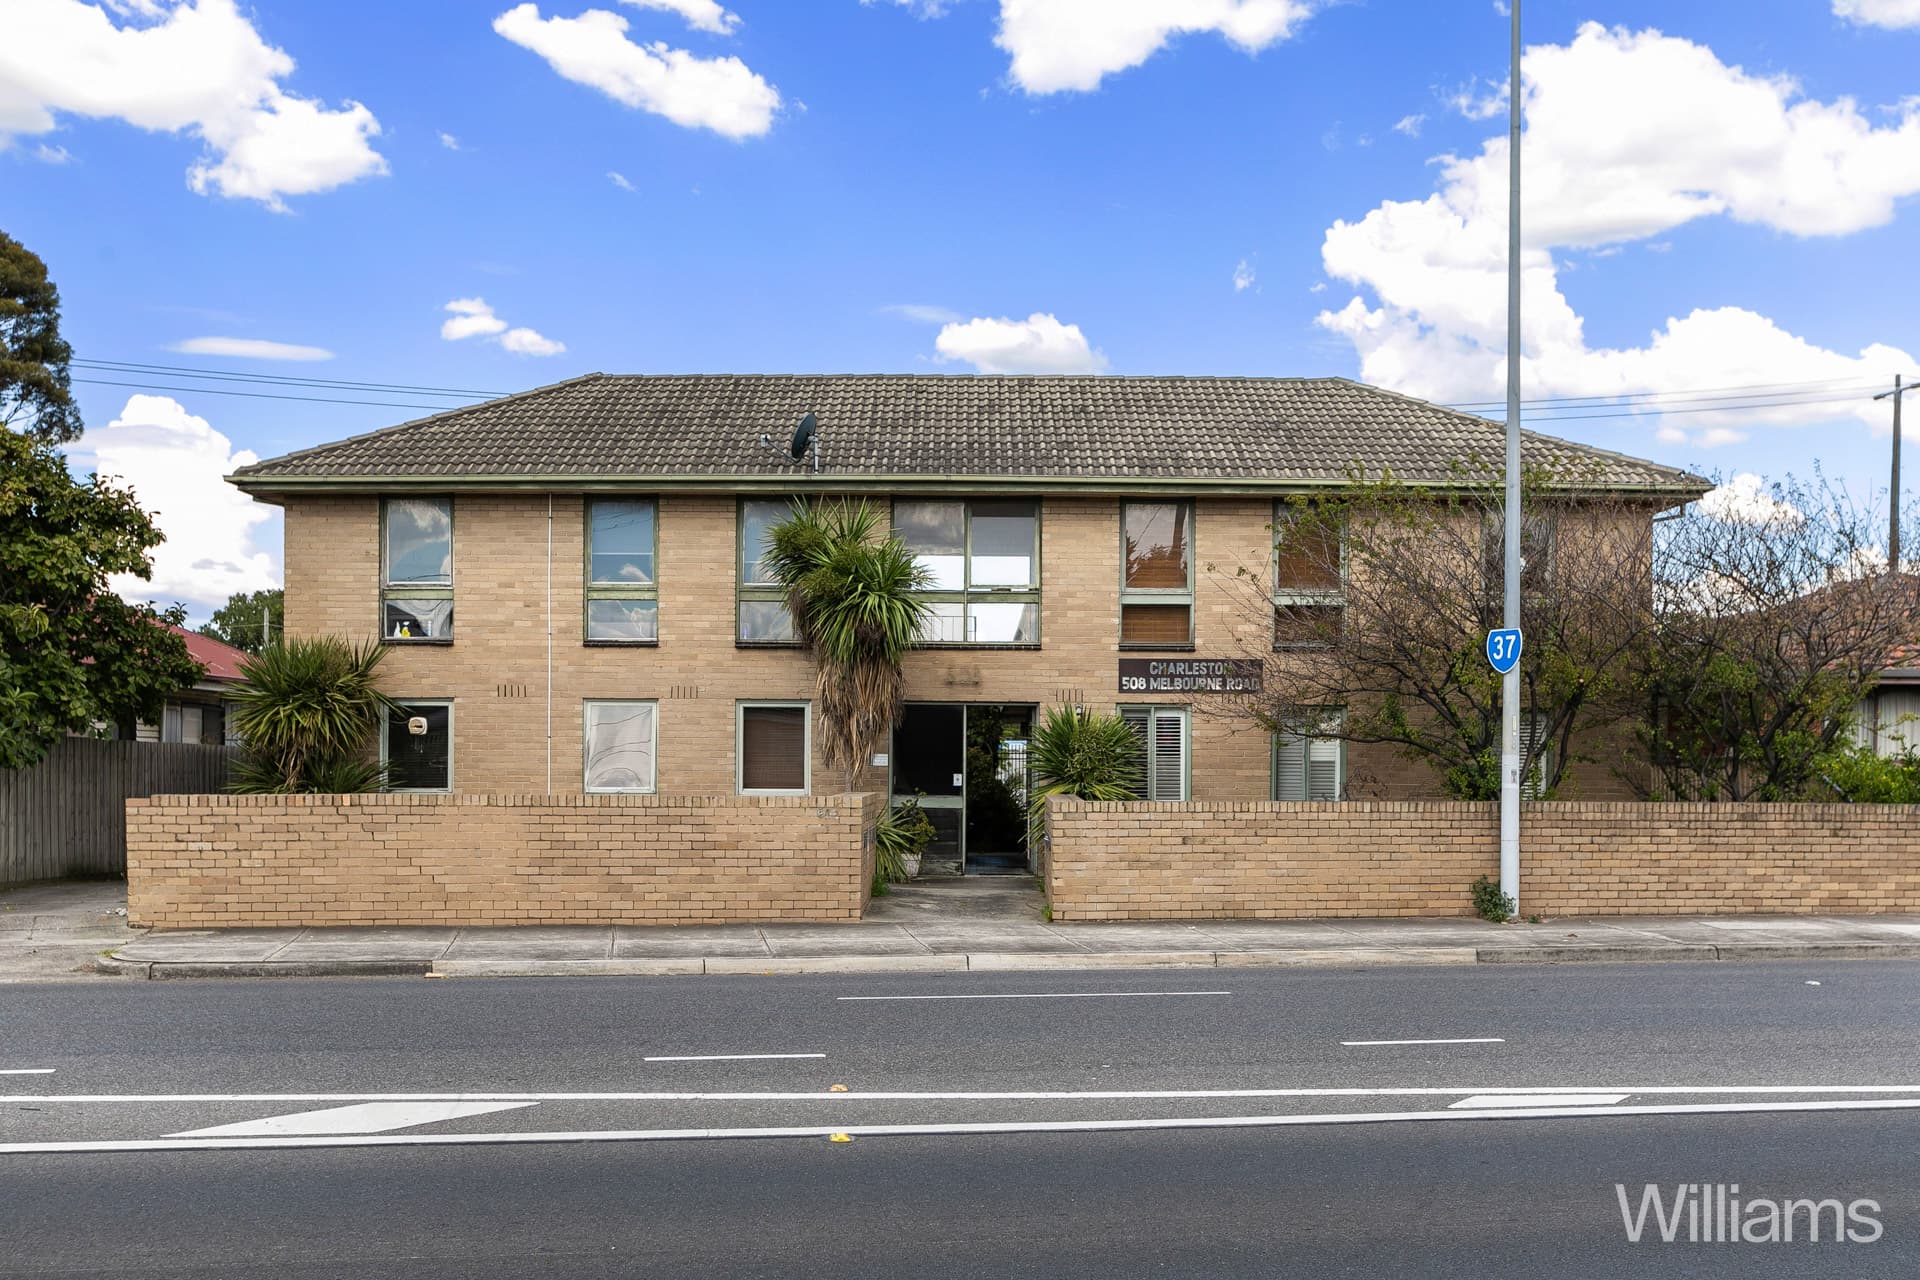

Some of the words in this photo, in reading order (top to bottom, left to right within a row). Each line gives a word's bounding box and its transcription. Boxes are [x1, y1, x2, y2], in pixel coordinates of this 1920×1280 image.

[1493, 635, 1516, 660] 37
[1121, 677, 1147, 690] 508
[1149, 677, 1223, 690] MELBOURNE
